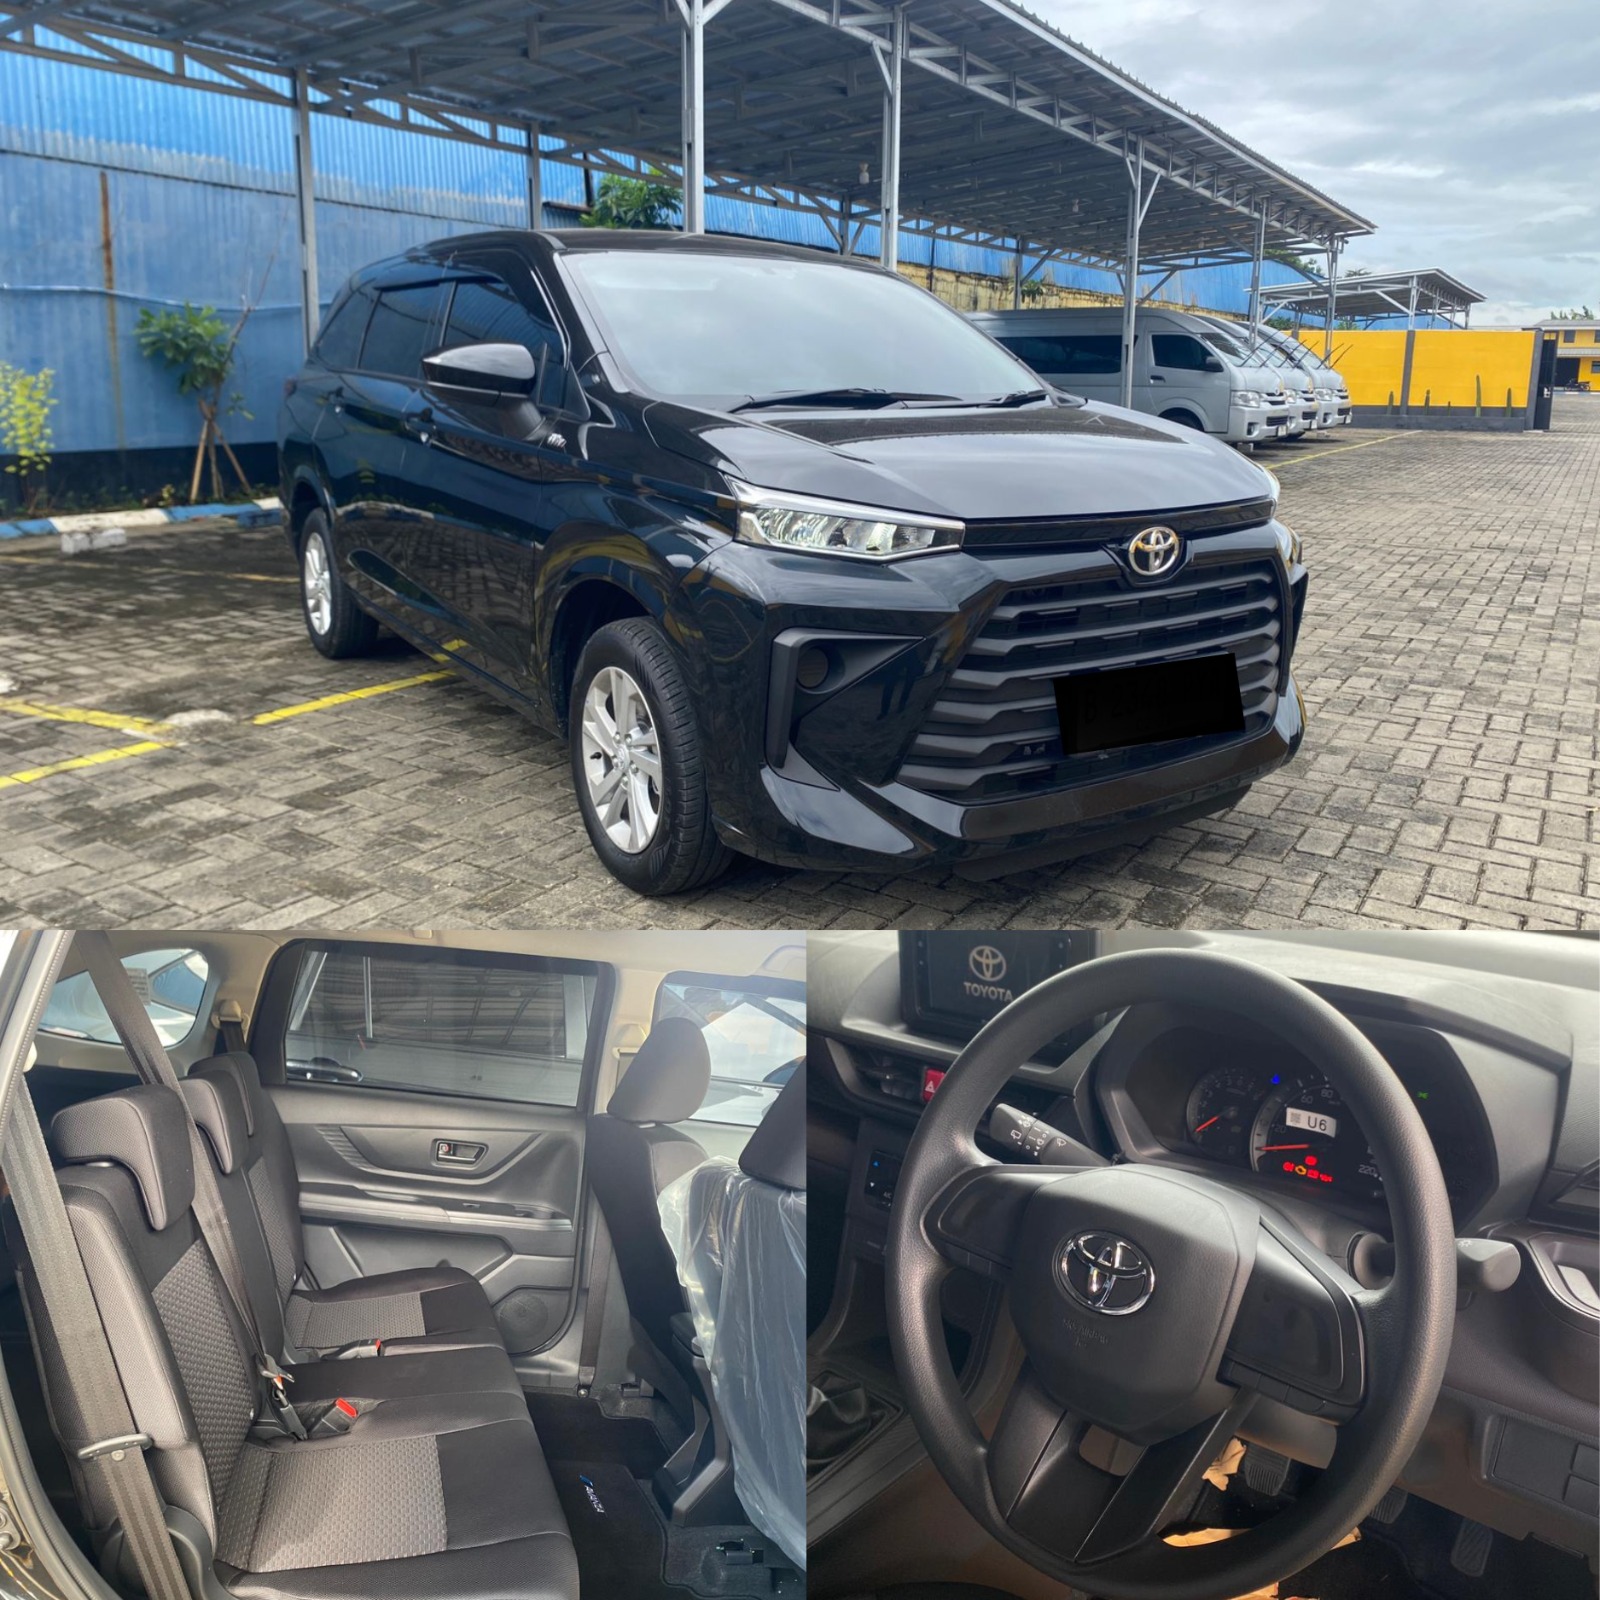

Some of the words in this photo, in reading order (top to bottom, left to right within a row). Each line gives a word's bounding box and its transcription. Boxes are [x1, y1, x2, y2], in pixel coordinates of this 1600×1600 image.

[963, 982, 1013, 1002] TOYOTA
[1300, 1094, 1314, 1105] 60
[1320, 1088, 1334, 1099] 80
[1307, 1115, 1327, 1132] U6
[1358, 1164, 1376, 1176] 220
